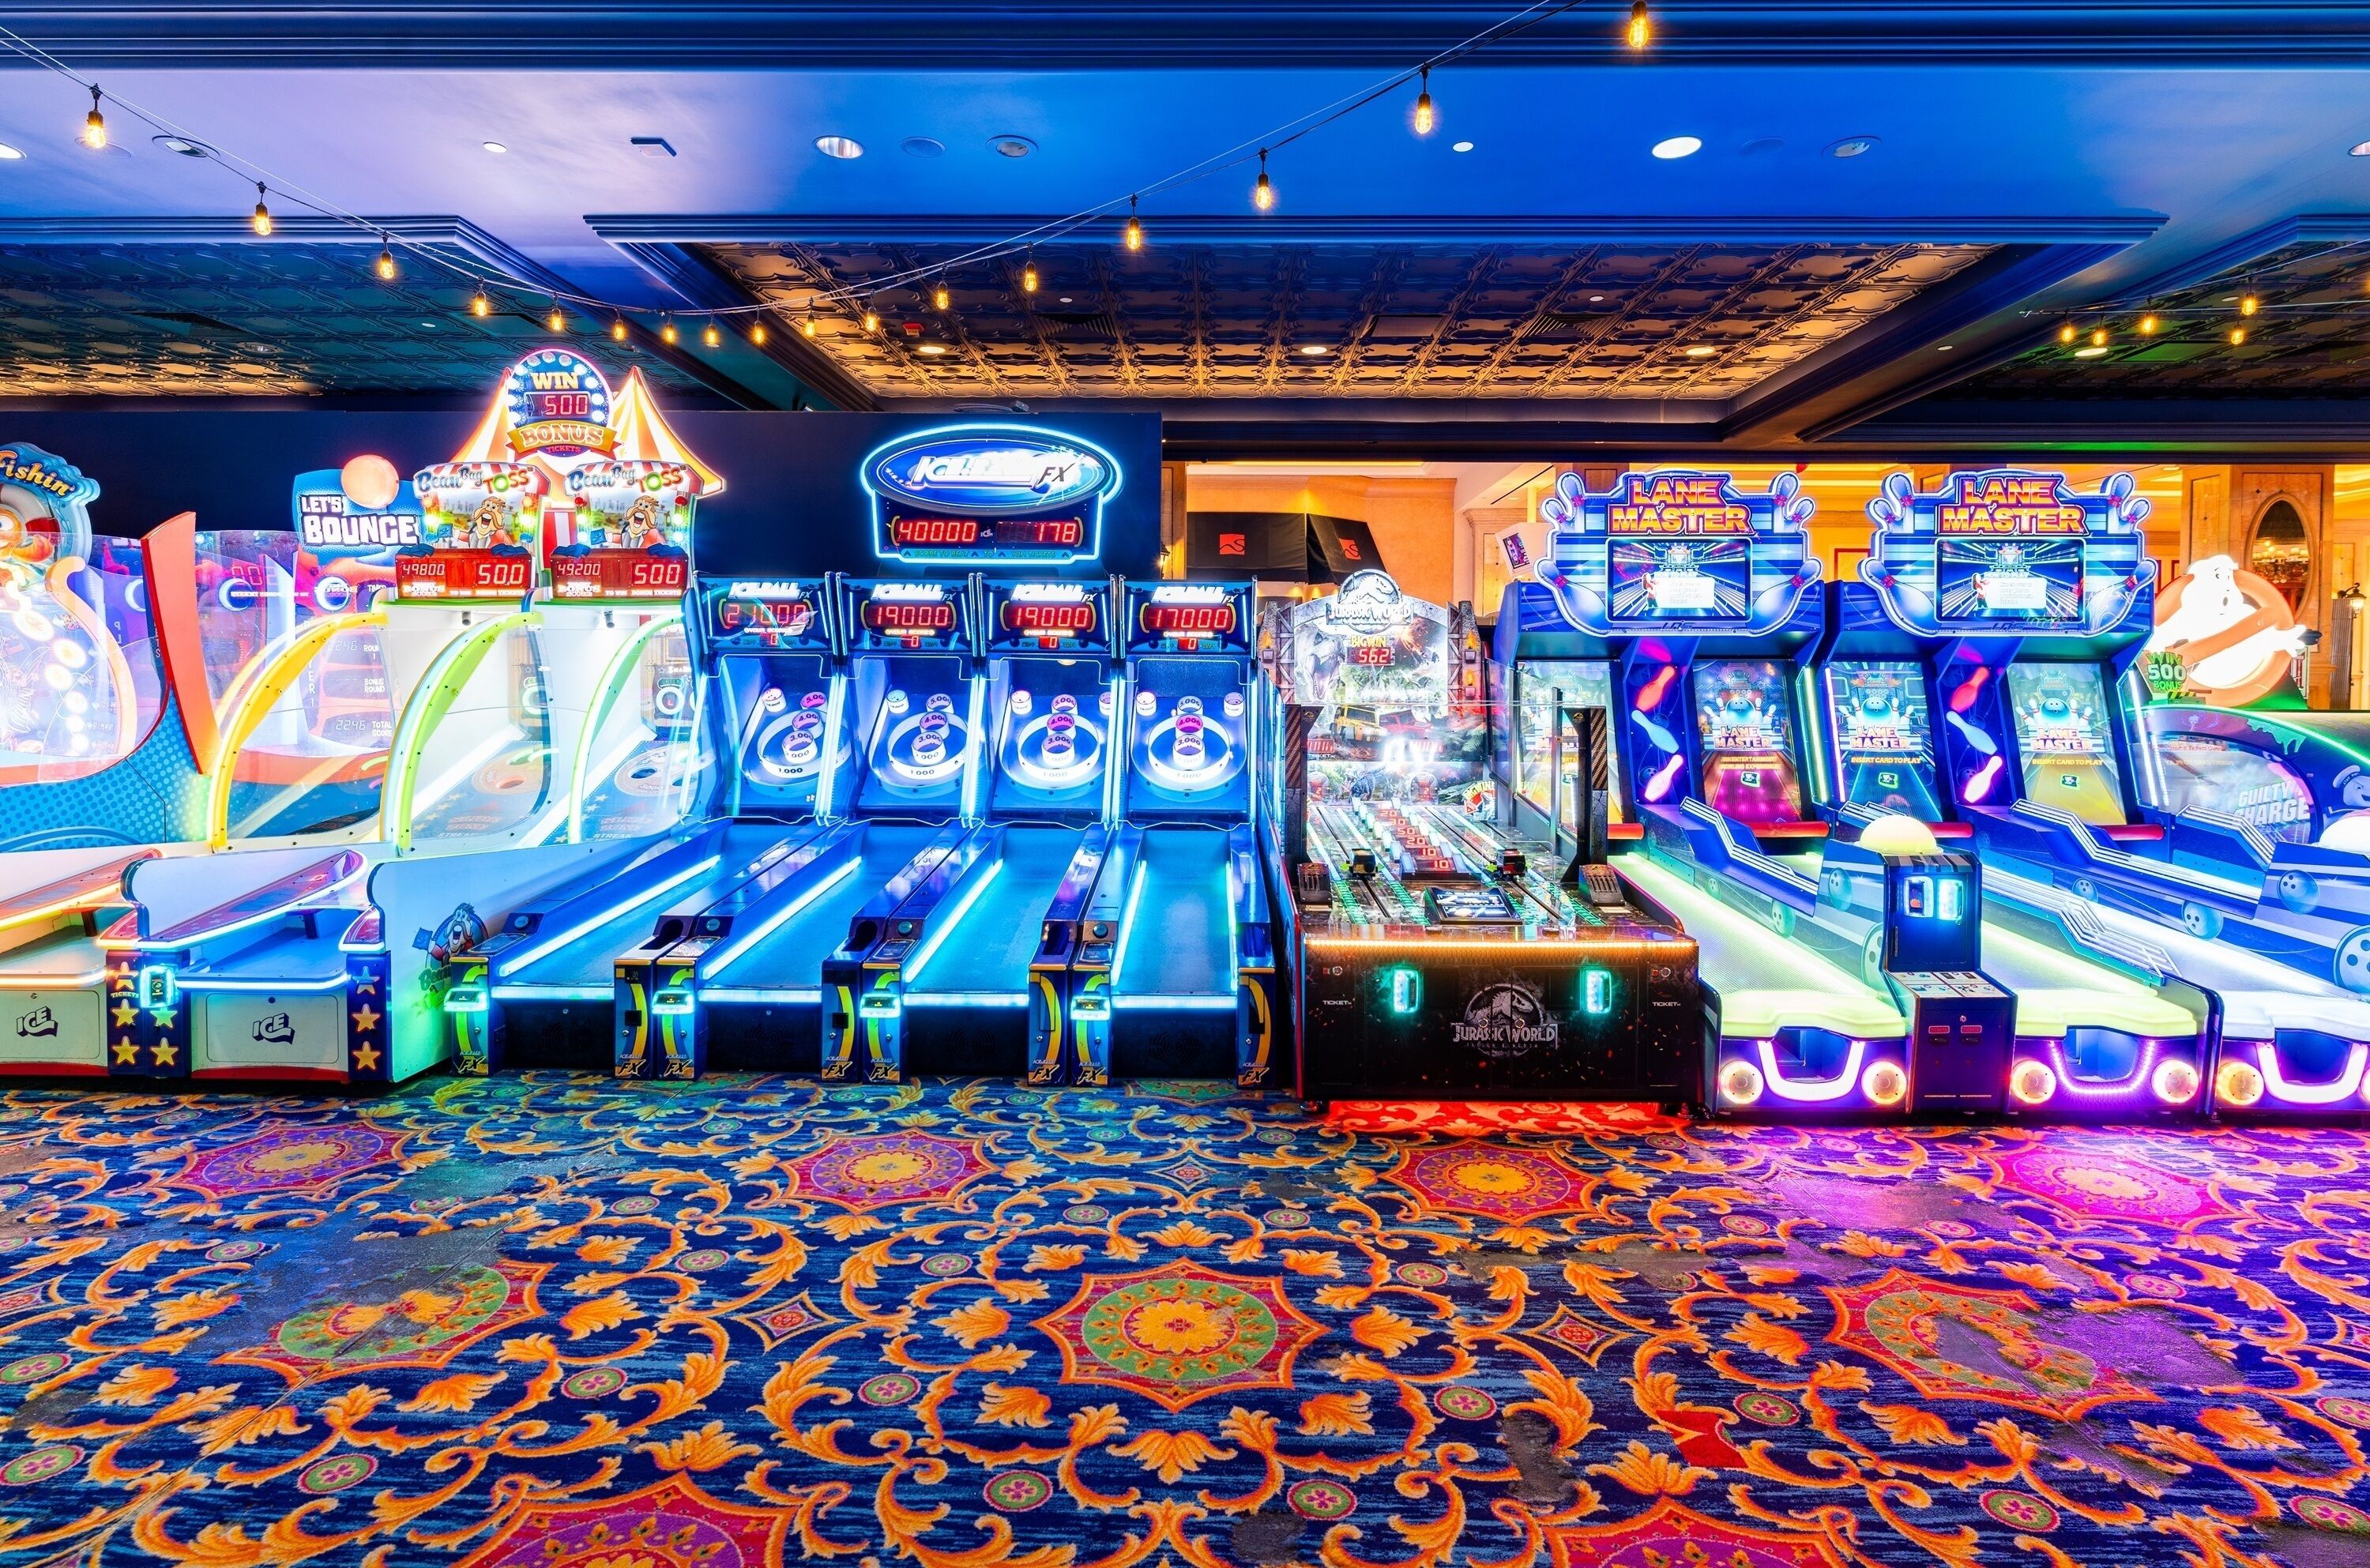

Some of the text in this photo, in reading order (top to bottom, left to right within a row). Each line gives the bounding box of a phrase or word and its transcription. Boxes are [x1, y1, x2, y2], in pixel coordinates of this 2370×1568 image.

[530, 372, 580, 390] WIN
[544, 394, 589, 416] 500
[519, 423, 604, 447] BONUS
[546, 445, 582, 453] TICKETS
[414, 471, 463, 492] Bean
[566, 469, 615, 492] Bean
[1632, 478, 1721, 505] LANE
[1963, 479, 2056, 505] LANE
[301, 495, 343, 513] LET'S
[1612, 506, 1748, 532] MASTER
[1942, 506, 2083, 532] MASTER
[303, 515, 418, 545] BOUNCE
[898, 521, 977, 543] 40000
[1039, 522, 1077, 543] 178
[402, 563, 446, 576] 49800
[557, 563, 601, 576] 49200
[634, 564, 681, 585] 500
[942, 592, 957, 601] FX
[1082, 593, 1097, 603] FX
[1222, 594, 1239, 604] FX
[877, 606, 949, 626] 19000
[1017, 607, 1089, 627] 19000
[1156, 608, 1229, 628] 17000
[911, 636, 919, 647] 0
[1049, 637, 1058, 648] 0
[1188, 637, 1197, 649] 0
[1358, 648, 1390, 664] 562
[2145, 652, 2183, 665] WIN
[2147, 664, 2188, 682] 500
[2154, 680, 2184, 692] BONUS
[372, 720, 393, 729] TOTAL
[1721, 726, 1759, 737] LANE
[1857, 726, 1896, 738] LANE
[2038, 727, 2078, 739] LANE
[1715, 737, 1770, 748] MASTER
[1850, 738, 1910, 749] MASTER
[2032, 739, 2094, 750] MASTER
[2237, 780, 2293, 807] GUILTY
[1398, 827, 1416, 836] 50
[1406, 837, 1426, 845] 20
[1422, 848, 1437, 857] 10
[1434, 859, 1450, 870] 10
[110, 991, 140, 999] TICKETS
[16, 1006, 58, 1037] ICE
[252, 1012, 295, 1044] ICE
[1450, 1022, 1556, 1043] JURASSIC WORLD
